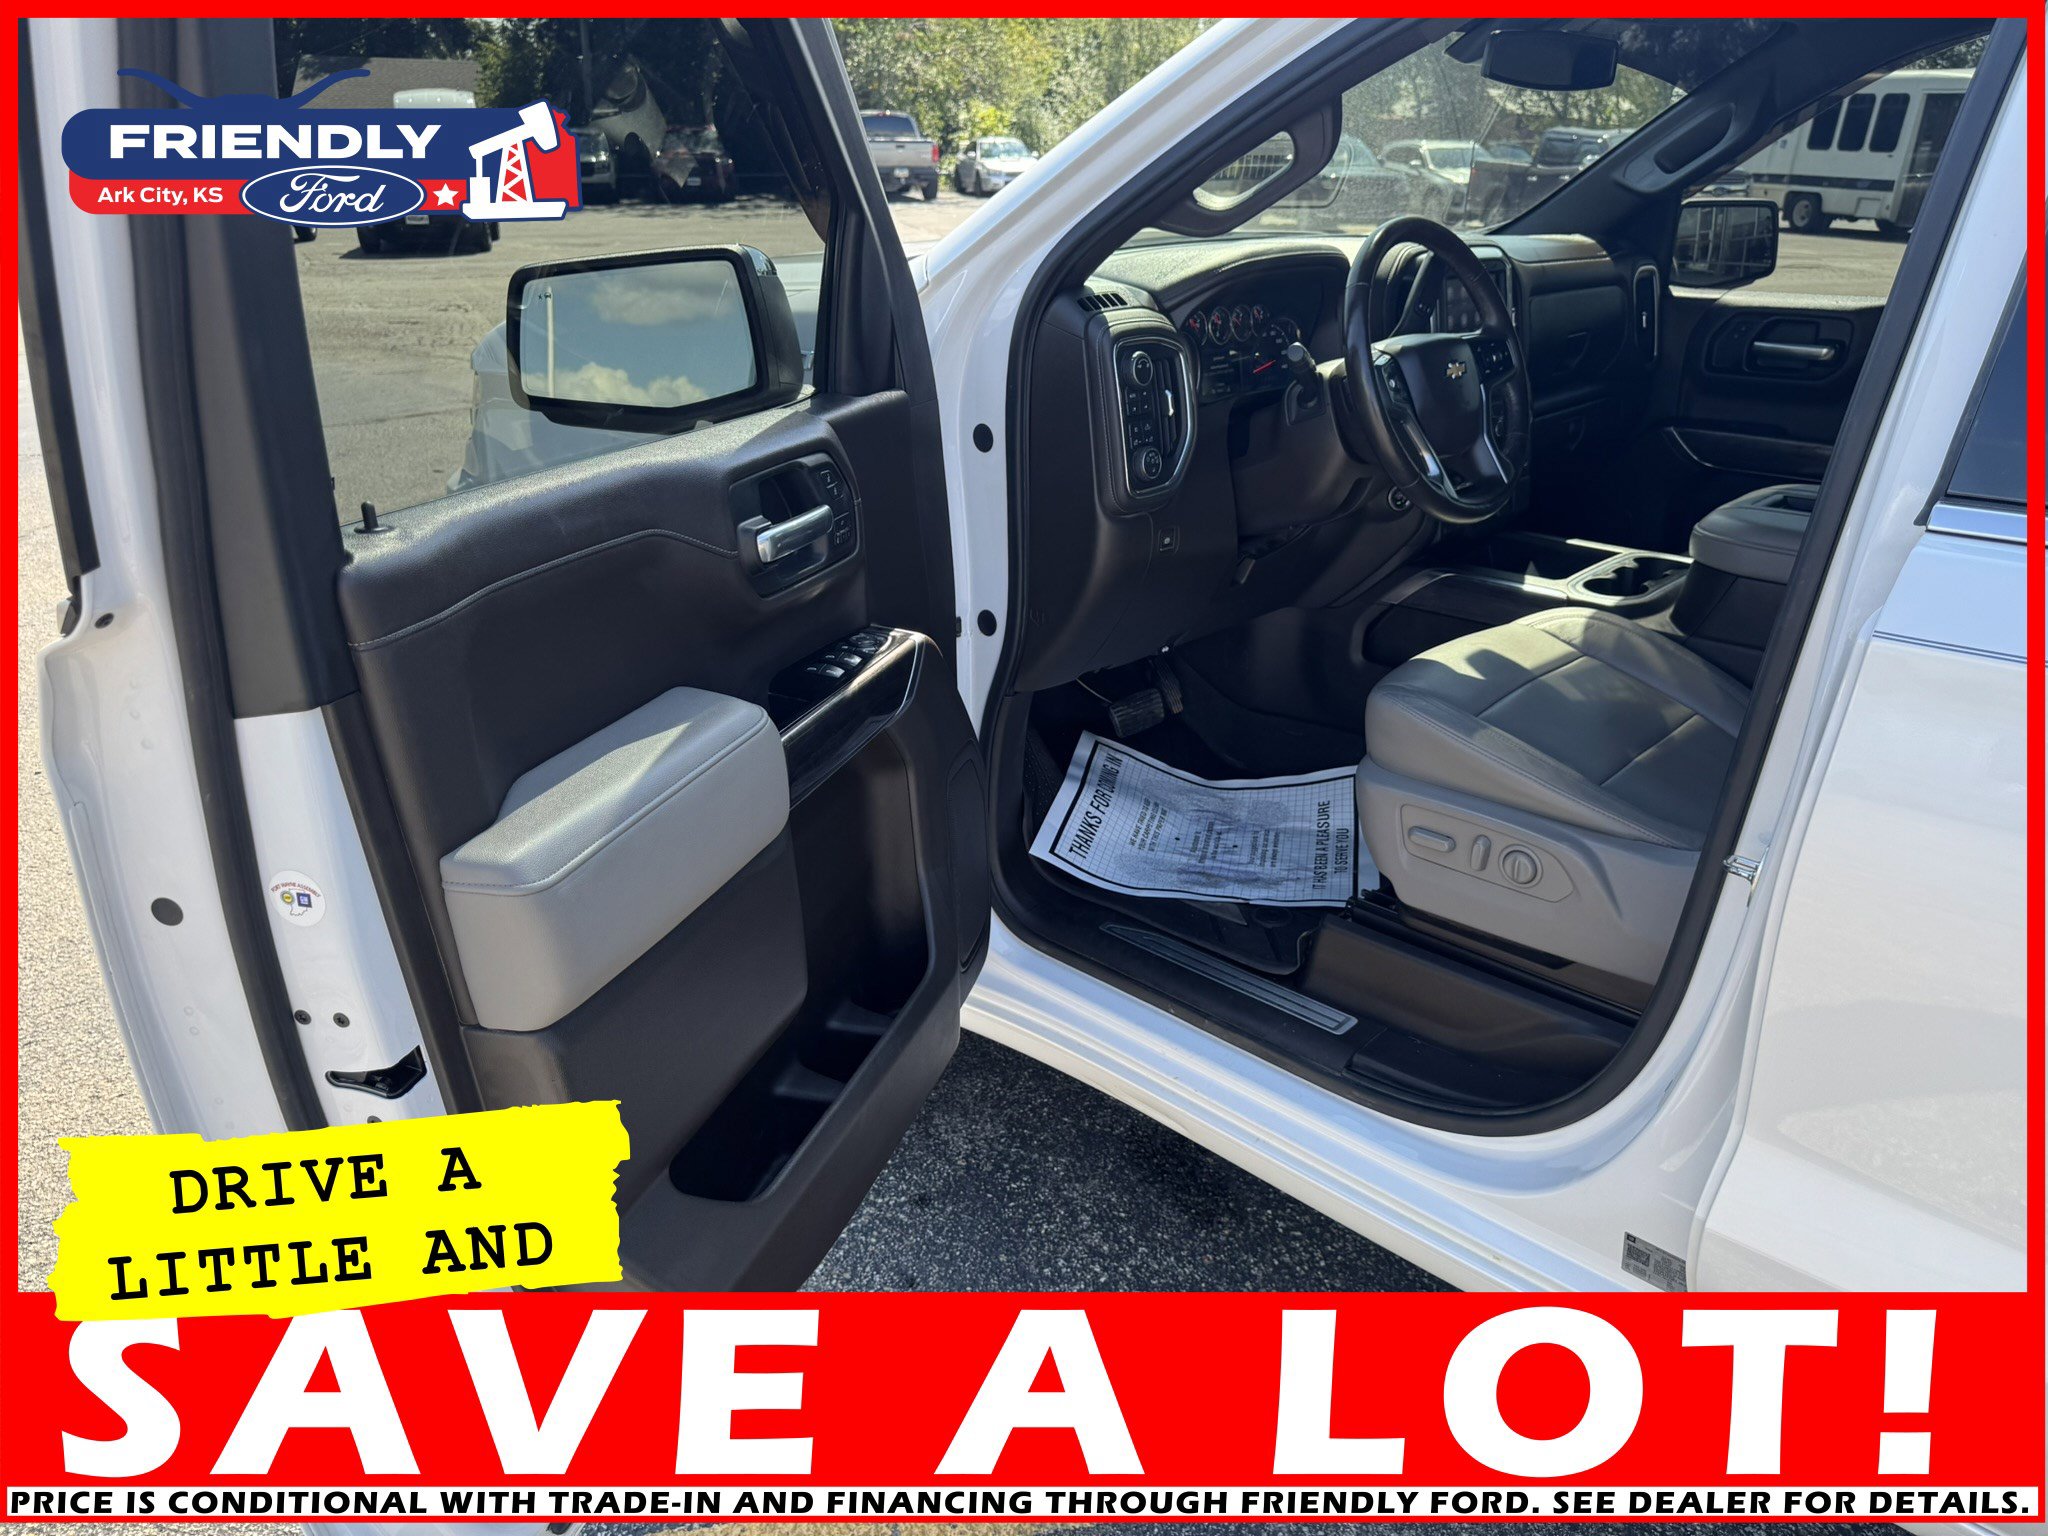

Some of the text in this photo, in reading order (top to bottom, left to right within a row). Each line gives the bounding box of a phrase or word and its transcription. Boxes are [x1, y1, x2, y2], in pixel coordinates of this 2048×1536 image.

[1069, 811, 1102, 859] THANKS
[1090, 788, 1113, 815] FOR
[1105, 752, 1123, 768] IN
[1316, 800, 1331, 846] PLEASURE
[1314, 853, 1328, 870] BEEN
[1334, 828, 1350, 874] TO SERVE YOU
[1313, 870, 1328, 884] HAS
